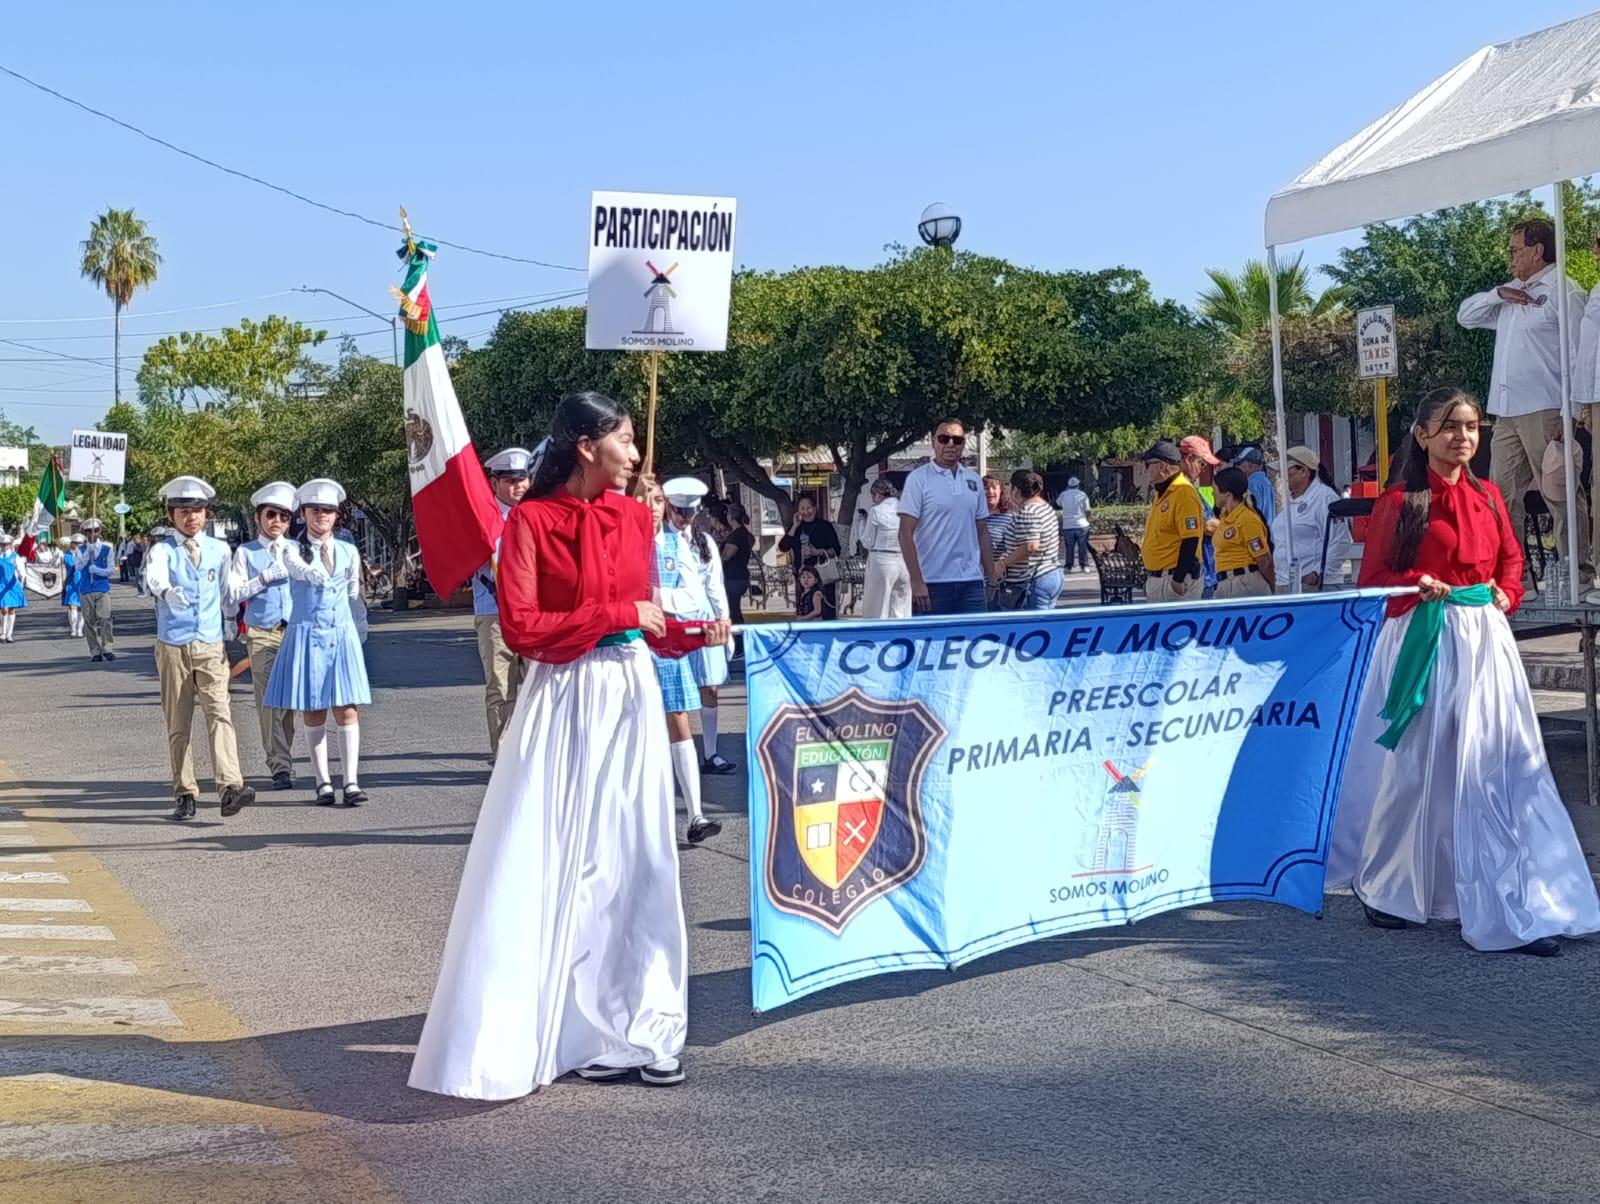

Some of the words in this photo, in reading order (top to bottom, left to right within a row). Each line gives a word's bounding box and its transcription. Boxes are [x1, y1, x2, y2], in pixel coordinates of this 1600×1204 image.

[594, 203, 732, 252] PARTICIPACIÓN
[621, 337, 656, 346] SOMOS
[657, 338, 694, 346] MOLINO
[1363, 347, 1390, 360] TAXIS
[1381, 335, 1390, 343] DE
[73, 434, 126, 451] LEGALIDAD
[838, 629, 1052, 675] COLEGIO
[1062, 626, 1104, 657] EL
[1116, 612, 1294, 654] MOLINO
[1047, 672, 1242, 716] PREESCOLAR
[795, 727, 814, 742] EL
[826, 723, 897, 738] MOLINO
[946, 727, 1092, 775] PRIMARIA
[1126, 700, 1321, 748] SECUNDARIA
[792, 868, 885, 906] COLEGIO
[1049, 881, 1107, 903] SOMOS
[1112, 869, 1169, 895] MOLINO
